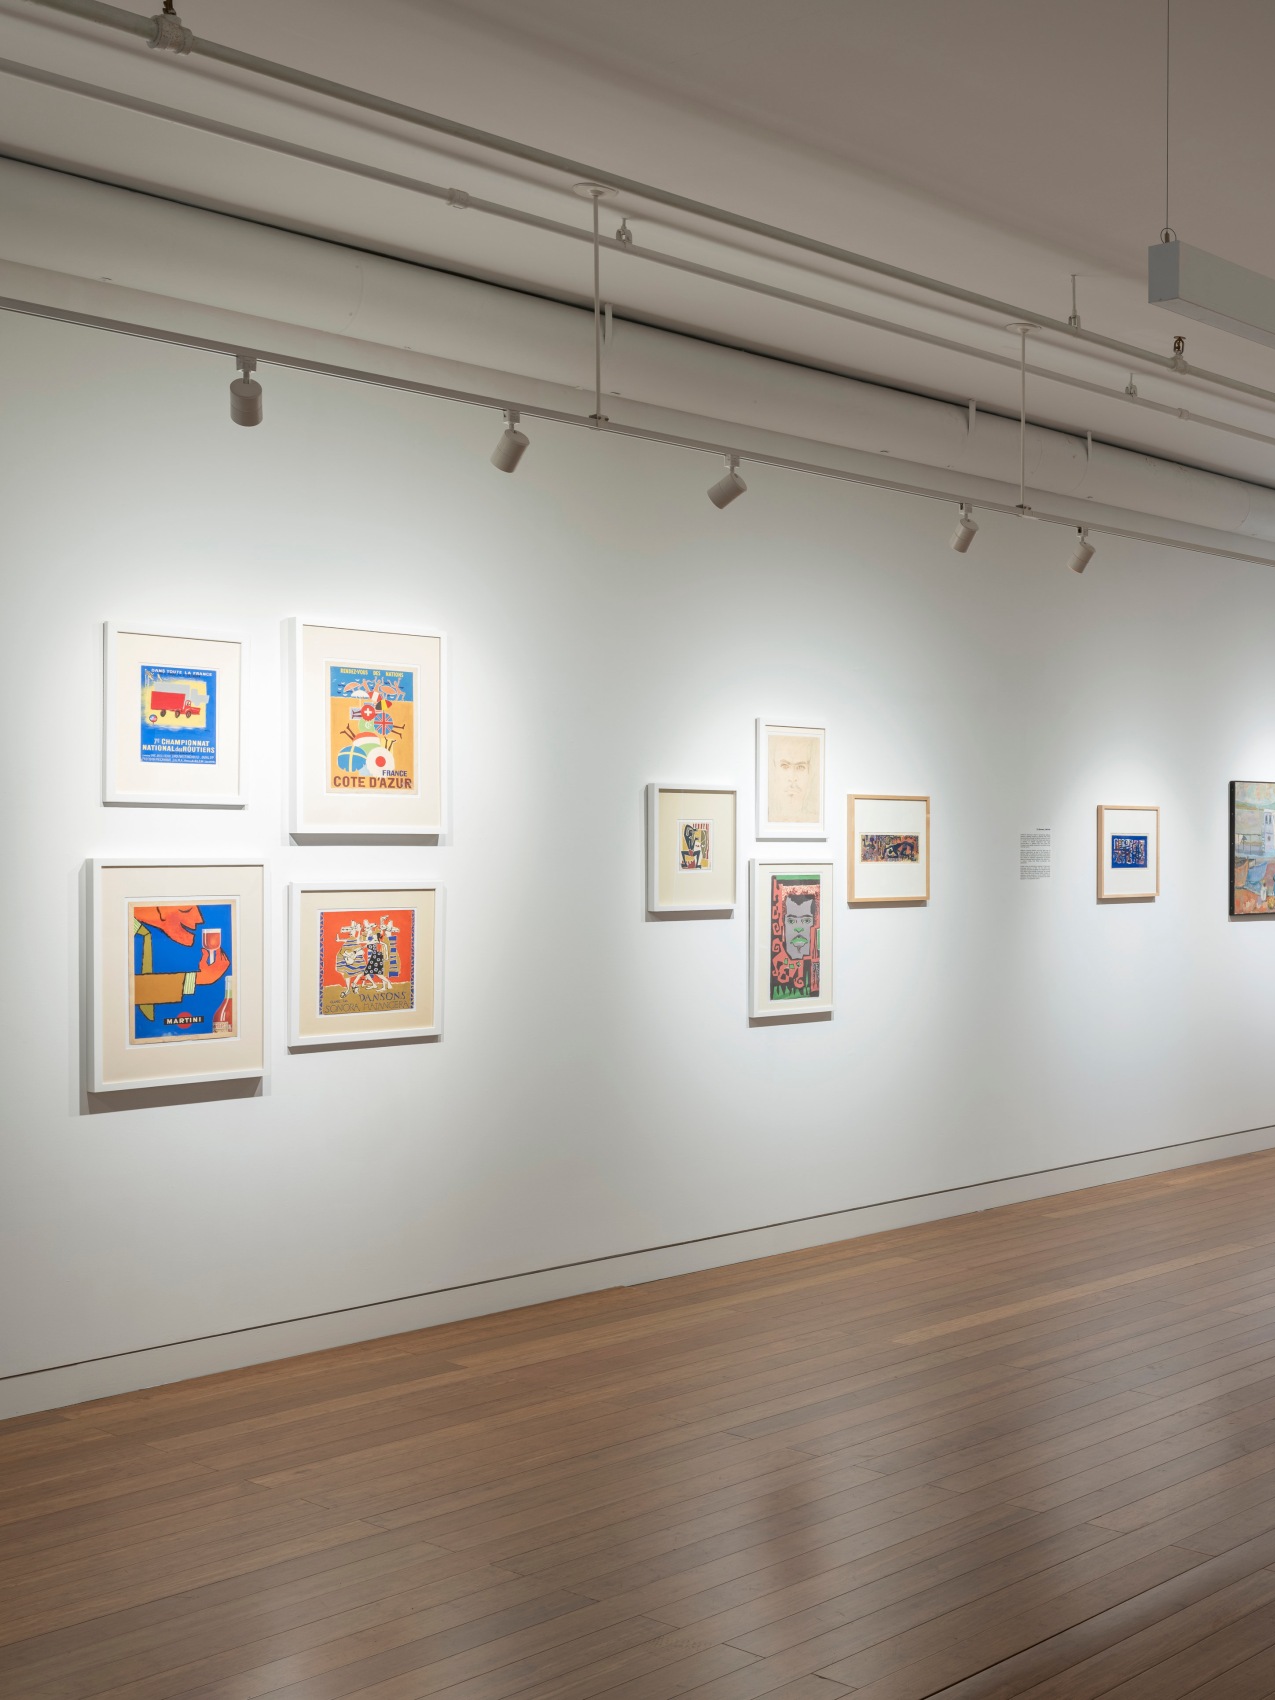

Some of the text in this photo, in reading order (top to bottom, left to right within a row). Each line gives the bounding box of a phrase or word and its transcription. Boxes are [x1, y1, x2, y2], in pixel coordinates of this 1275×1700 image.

[161, 738, 210, 747] CHAMPIONNAT
[142, 744, 174, 752] NATIONAL
[182, 746, 215, 754] ROUTIERS
[382, 769, 408, 777] FRANCE
[333, 775, 412, 789] COTE D'AZUR
[359, 992, 406, 1002] DANSONS
[325, 1003, 360, 1013] SONORA
